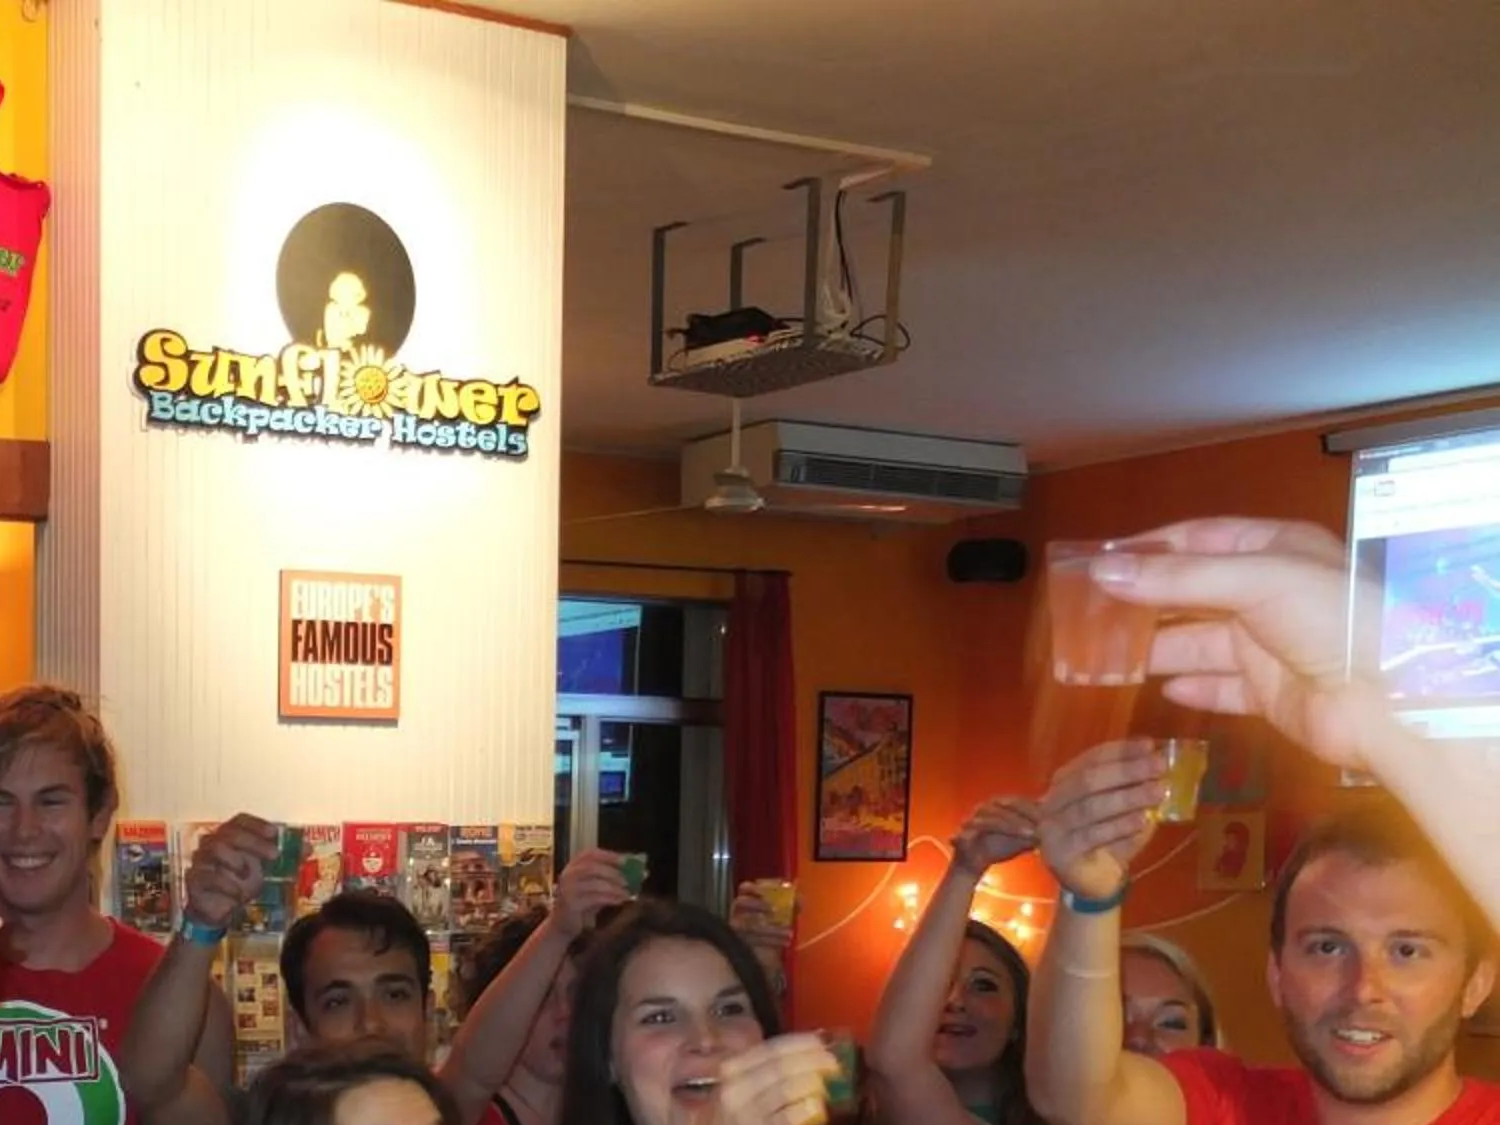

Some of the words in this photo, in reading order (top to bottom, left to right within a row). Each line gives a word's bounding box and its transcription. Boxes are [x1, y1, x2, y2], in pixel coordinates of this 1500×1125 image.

[134, 329, 541, 426] Sunflower
[148, 390, 383, 440] Backpacker
[390, 415, 529, 457] Hostels
[292, 619, 393, 665] FAMOUS
[290, 663, 393, 708] HOSTELS
